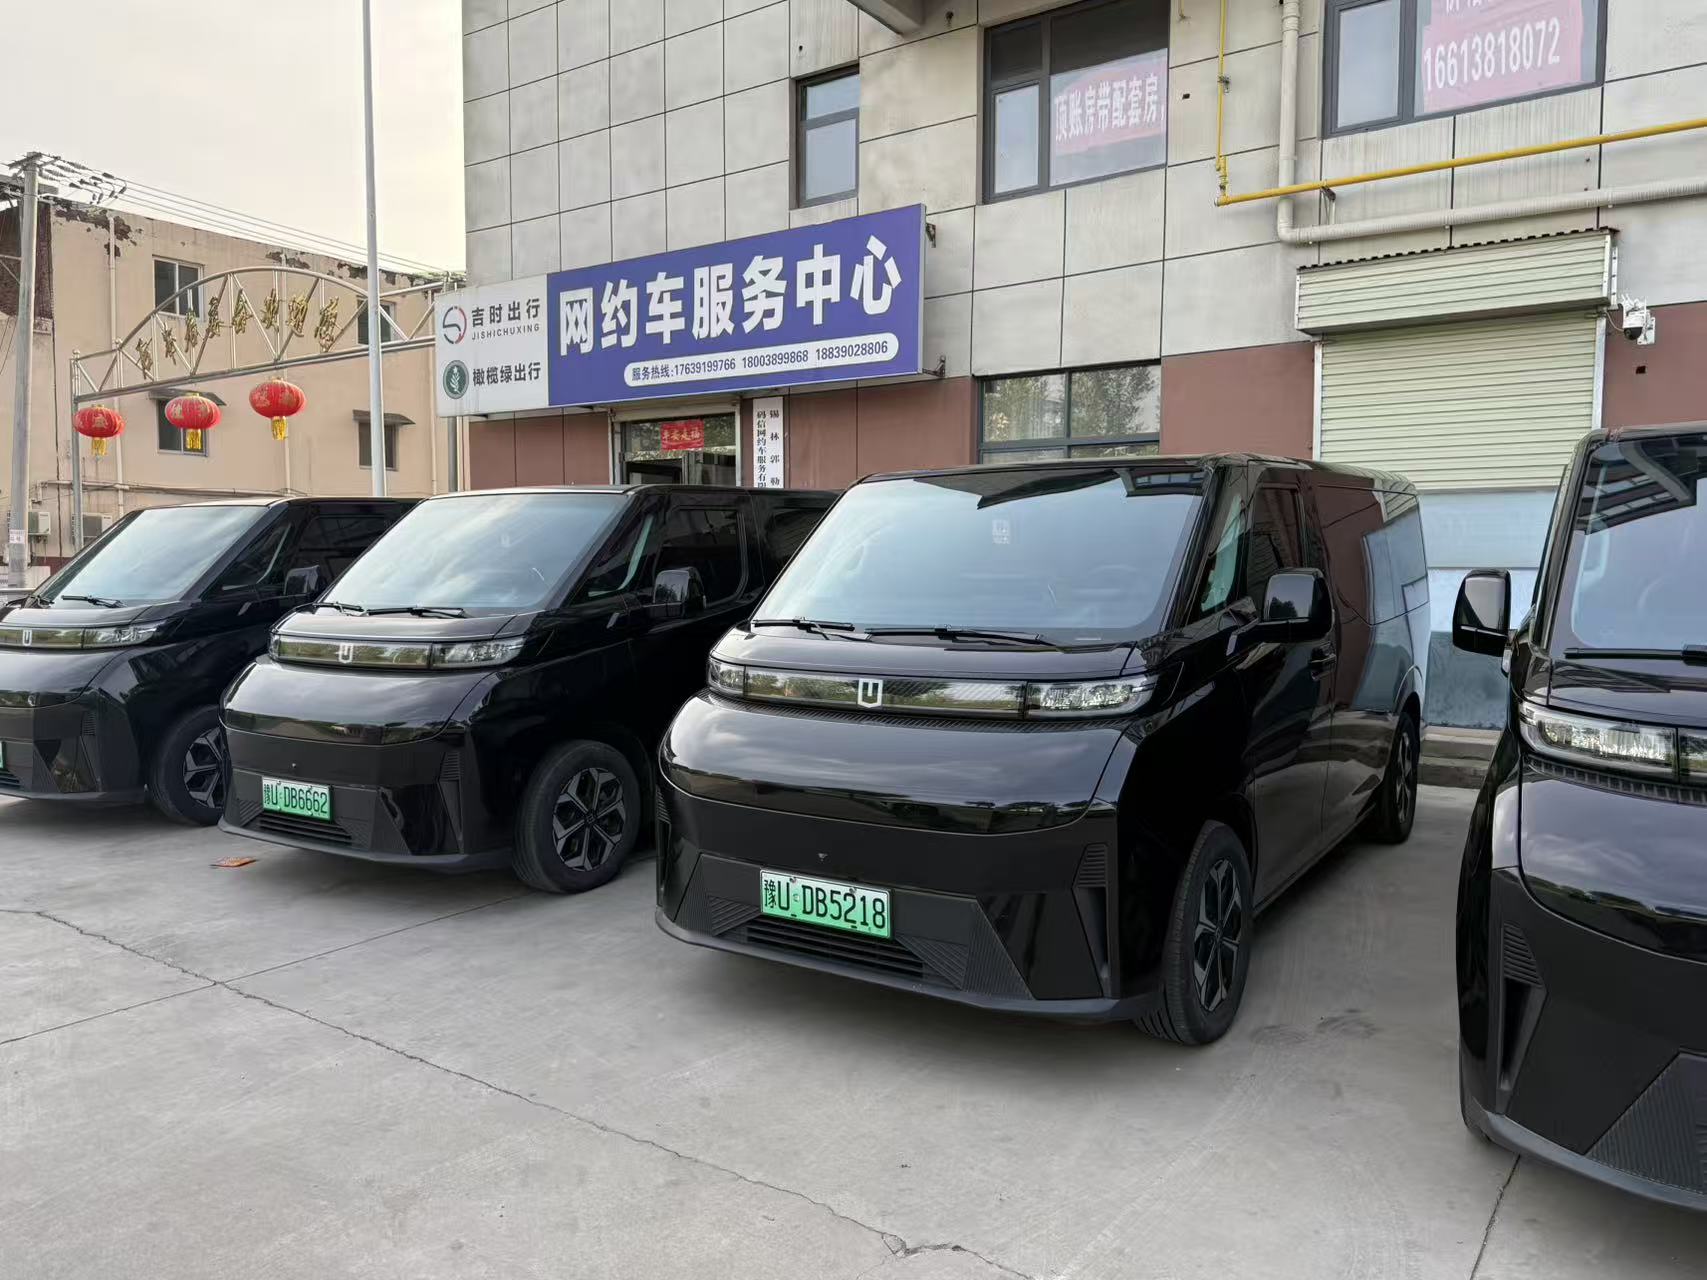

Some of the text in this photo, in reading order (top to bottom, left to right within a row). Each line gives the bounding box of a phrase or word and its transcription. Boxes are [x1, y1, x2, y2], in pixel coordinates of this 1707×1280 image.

[1424, 17, 1560, 91] 16613818072
[560, 234, 902, 356] 网约车服务中心
[471, 298, 540, 328] 吉时出行
[471, 323, 540, 341] JISHICHUXING
[742, 349, 809, 369] 18003899868
[815, 340, 889, 361] 18839028806
[472, 362, 541, 387] 橄榄绿出行
